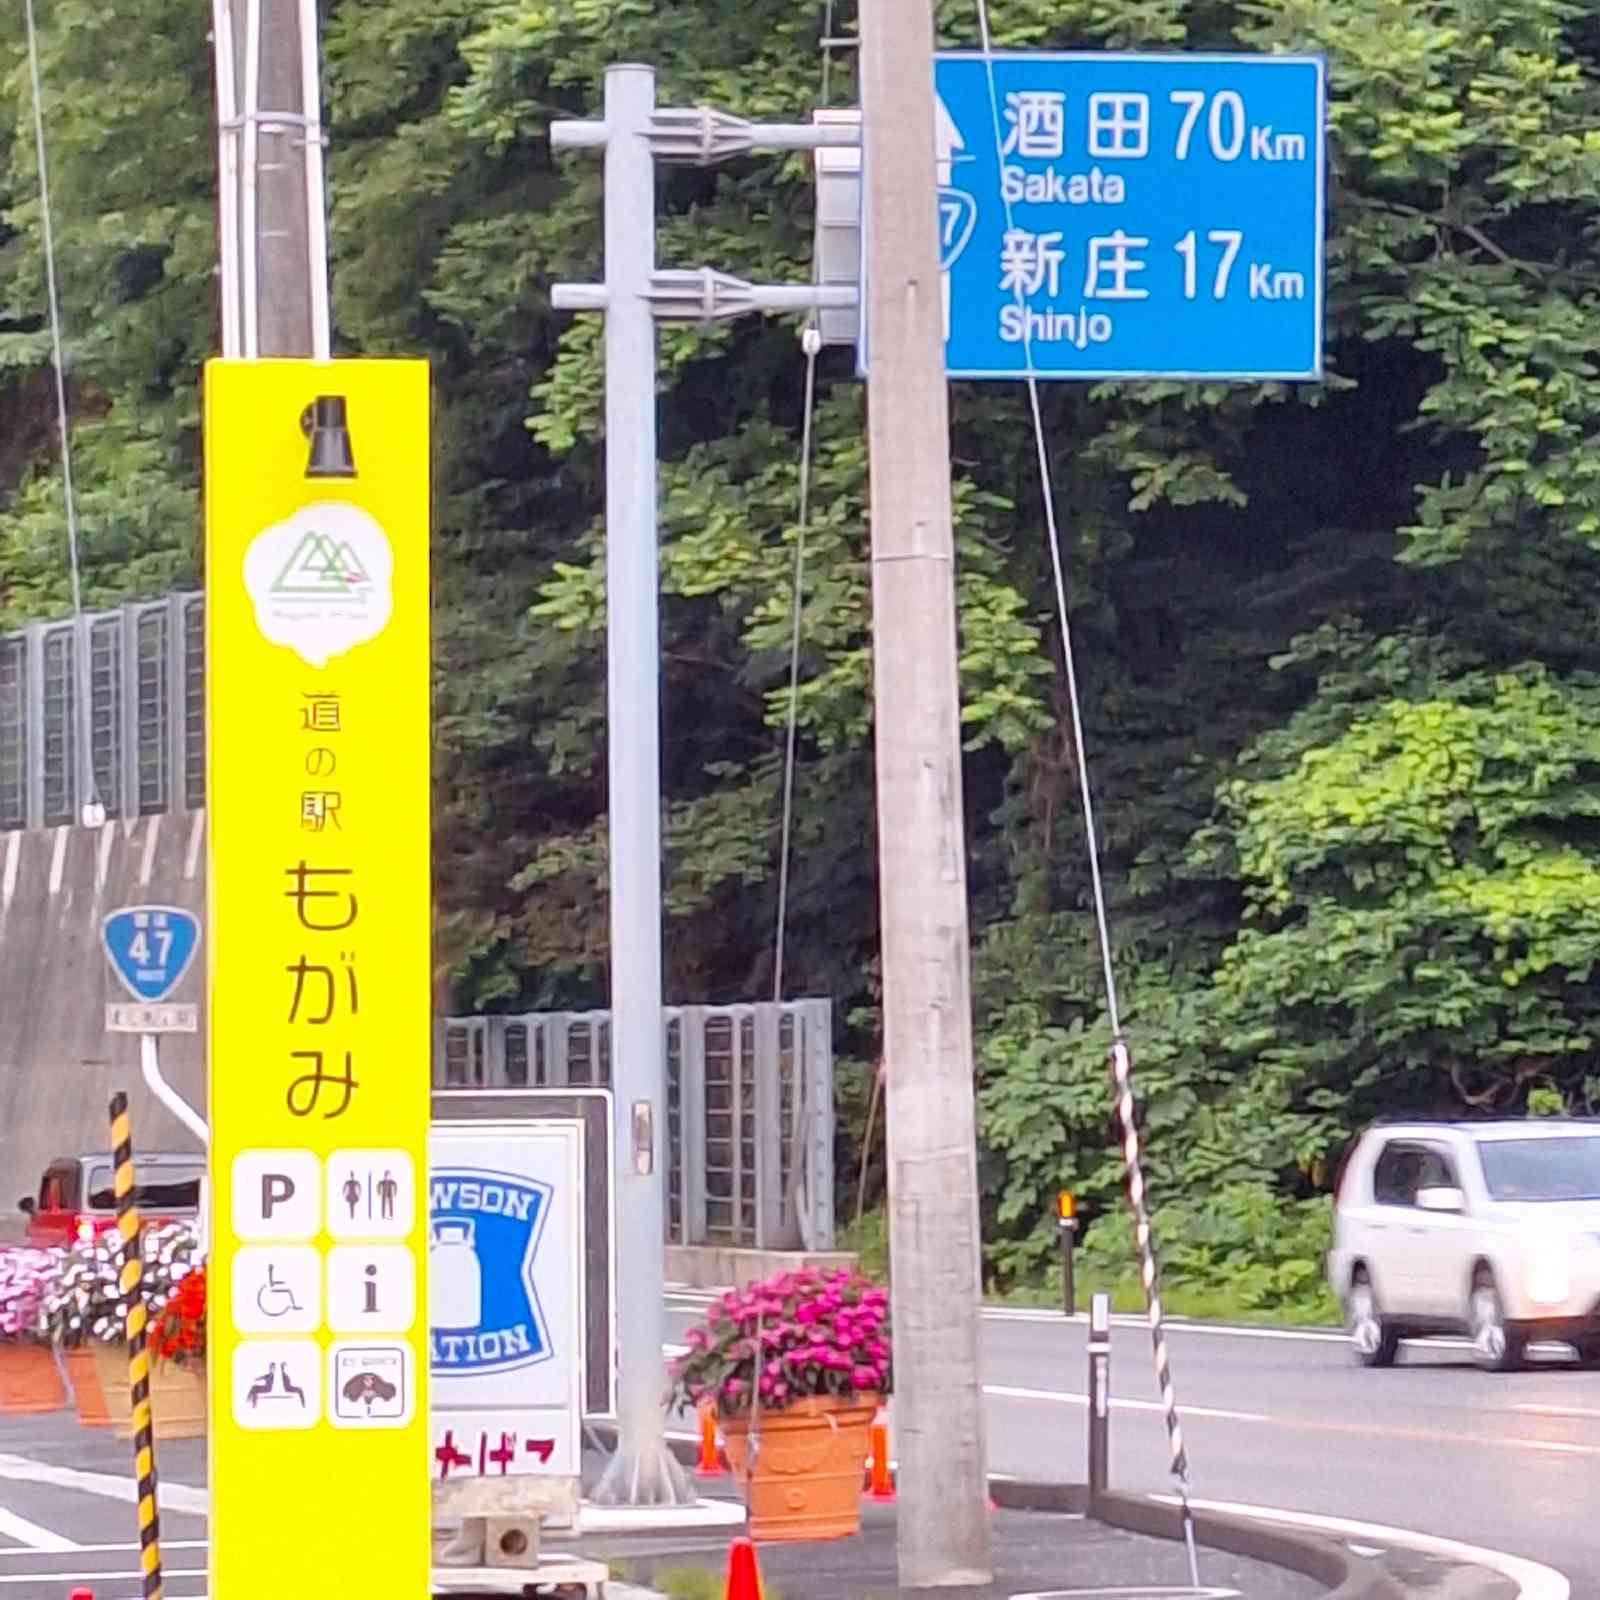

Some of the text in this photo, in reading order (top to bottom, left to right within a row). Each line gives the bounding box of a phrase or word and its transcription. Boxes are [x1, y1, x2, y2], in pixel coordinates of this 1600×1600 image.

[1003, 91, 1150, 158] 酒田
[1000, 166, 1125, 204] Sakata
[999, 229, 1150, 300] 新庄
[999, 305, 1112, 349] Shinjo
[299, 691, 343, 832] 道の駅
[129, 930, 173, 966] 47
[284, 860, 359, 1119] もがみ
[261, 1174, 295, 1219] P
